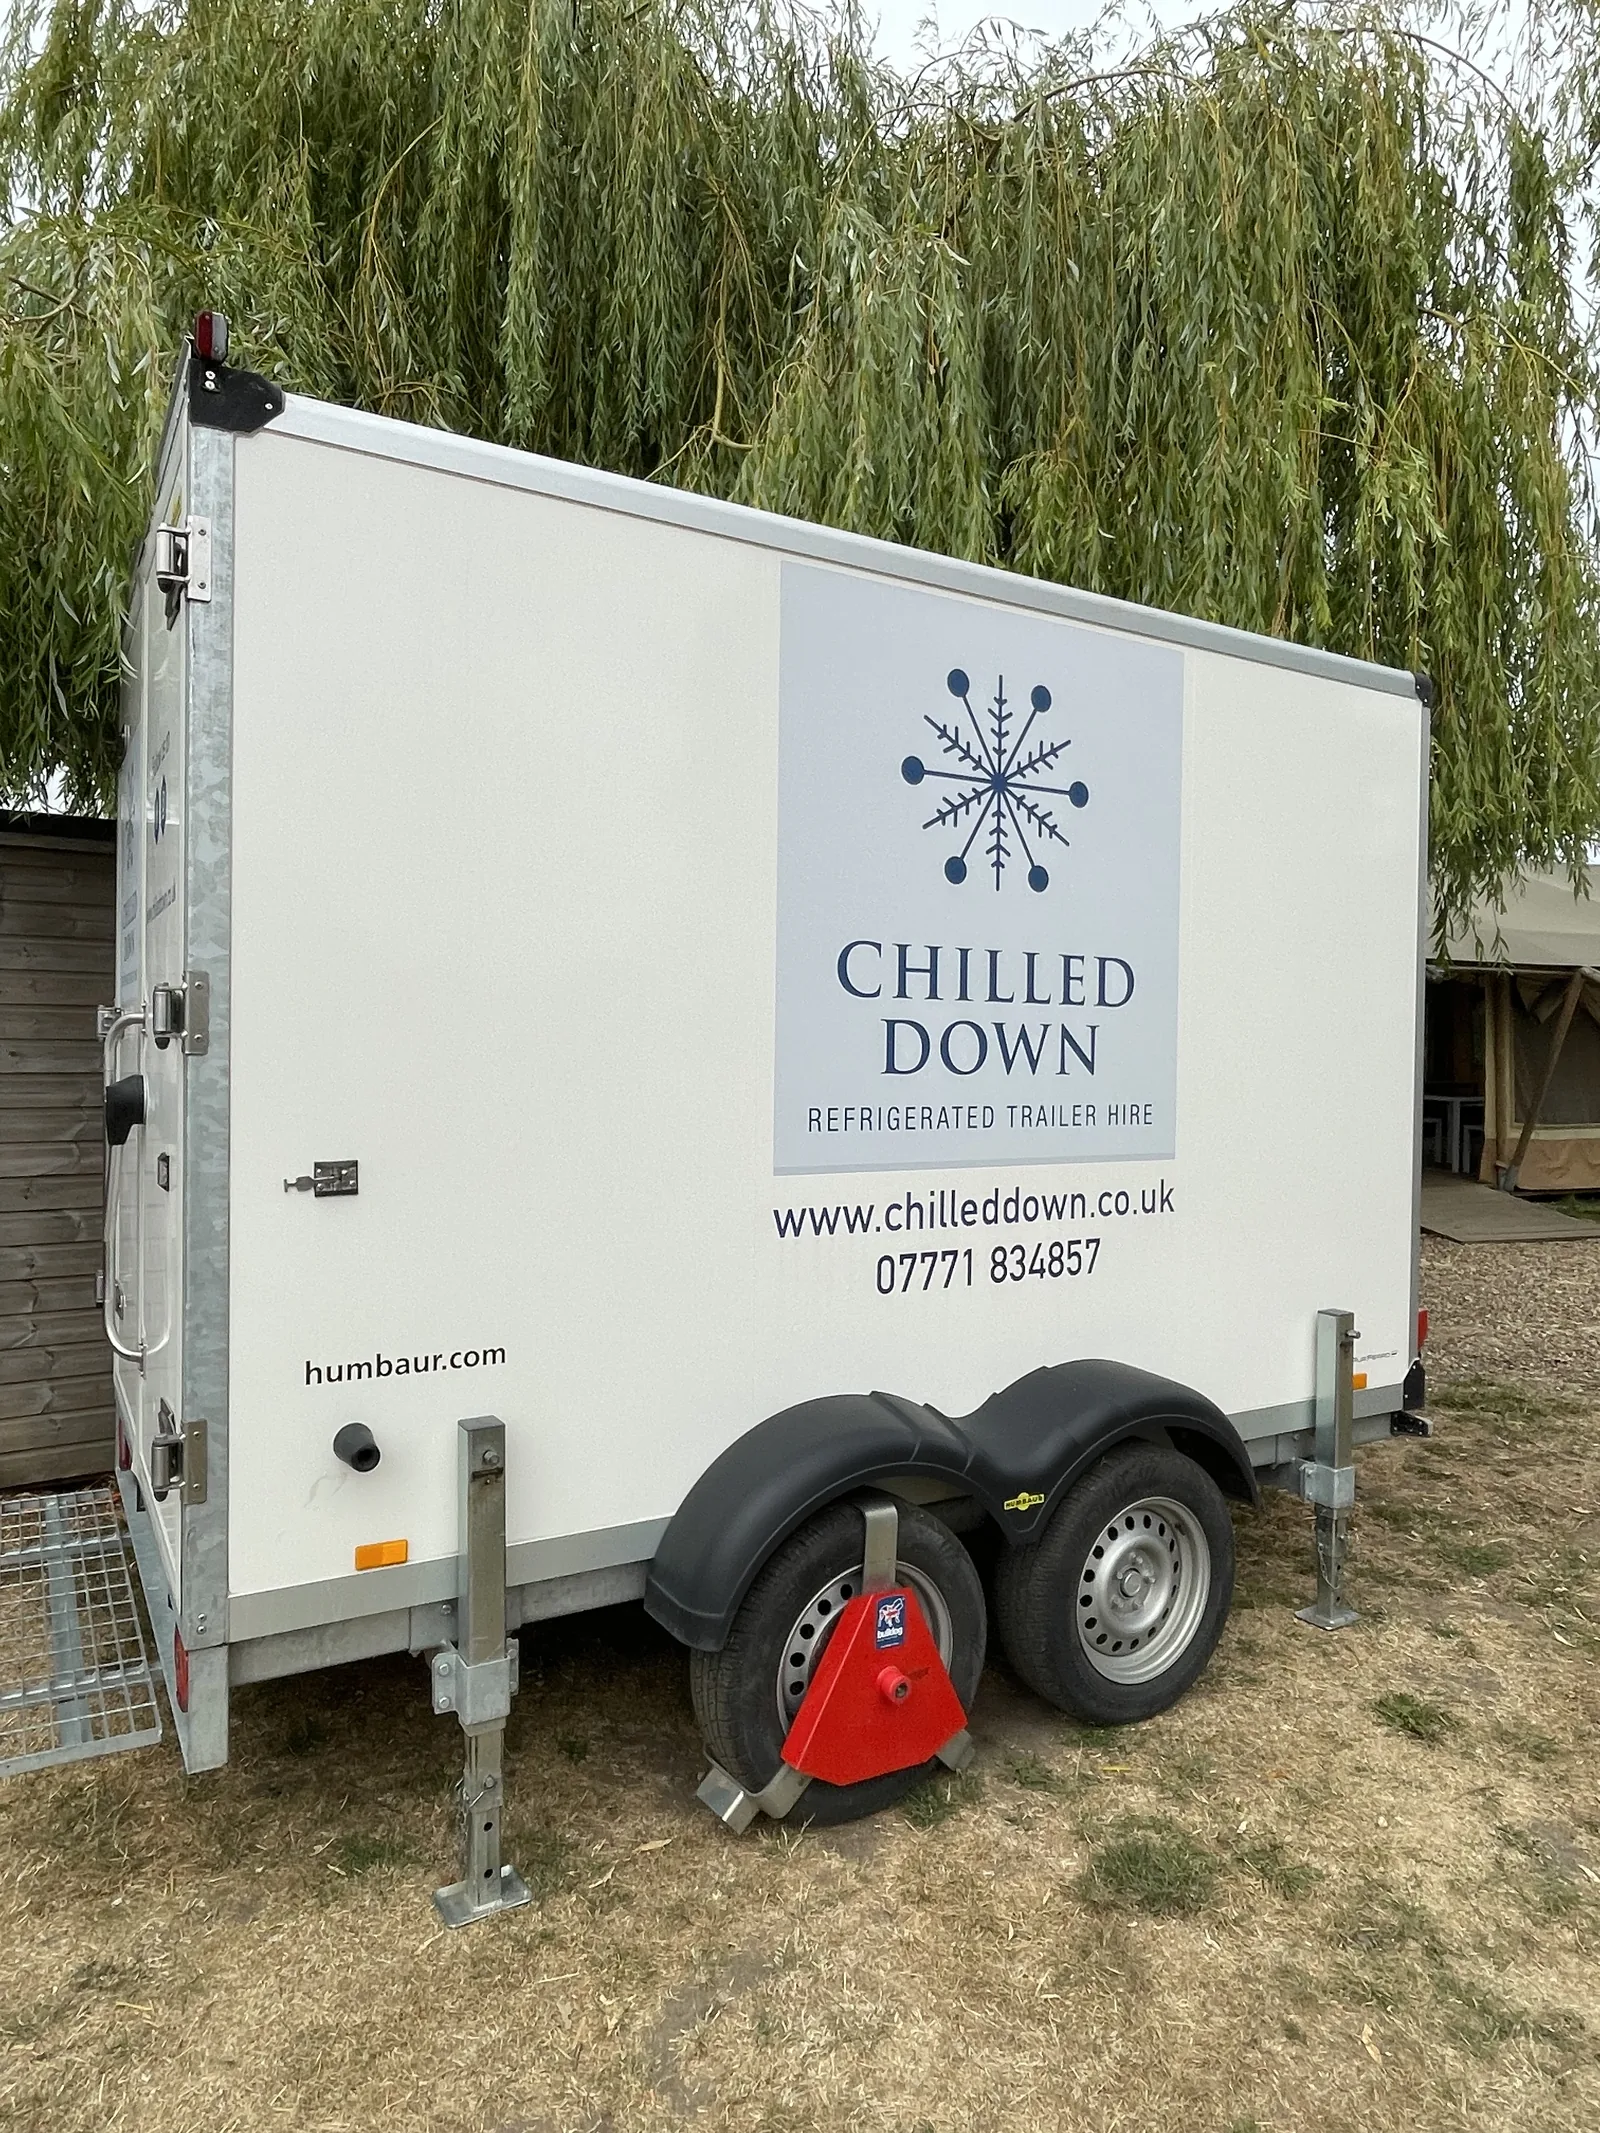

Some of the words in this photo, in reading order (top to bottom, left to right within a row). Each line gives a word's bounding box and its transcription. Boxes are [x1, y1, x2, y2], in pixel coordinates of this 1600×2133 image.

[836, 940, 1135, 1008] CHILLED
[880, 1018, 1100, 1076] DOWN
[807, 1105, 995, 1132] REFRIGERATED
[1006, 1104, 1097, 1129] TRAILER
[1107, 1103, 1154, 1126] HIRE
[773, 1178, 1175, 1238] www.chilleddown.co.uk
[876, 1248, 973, 1294] 07771
[990, 1238, 1101, 1283] 834857
[305, 1347, 506, 1385] humbaur.com
[1005, 1495, 1043, 1508] HUMBAUR
[877, 1626, 903, 1639] bulldog
